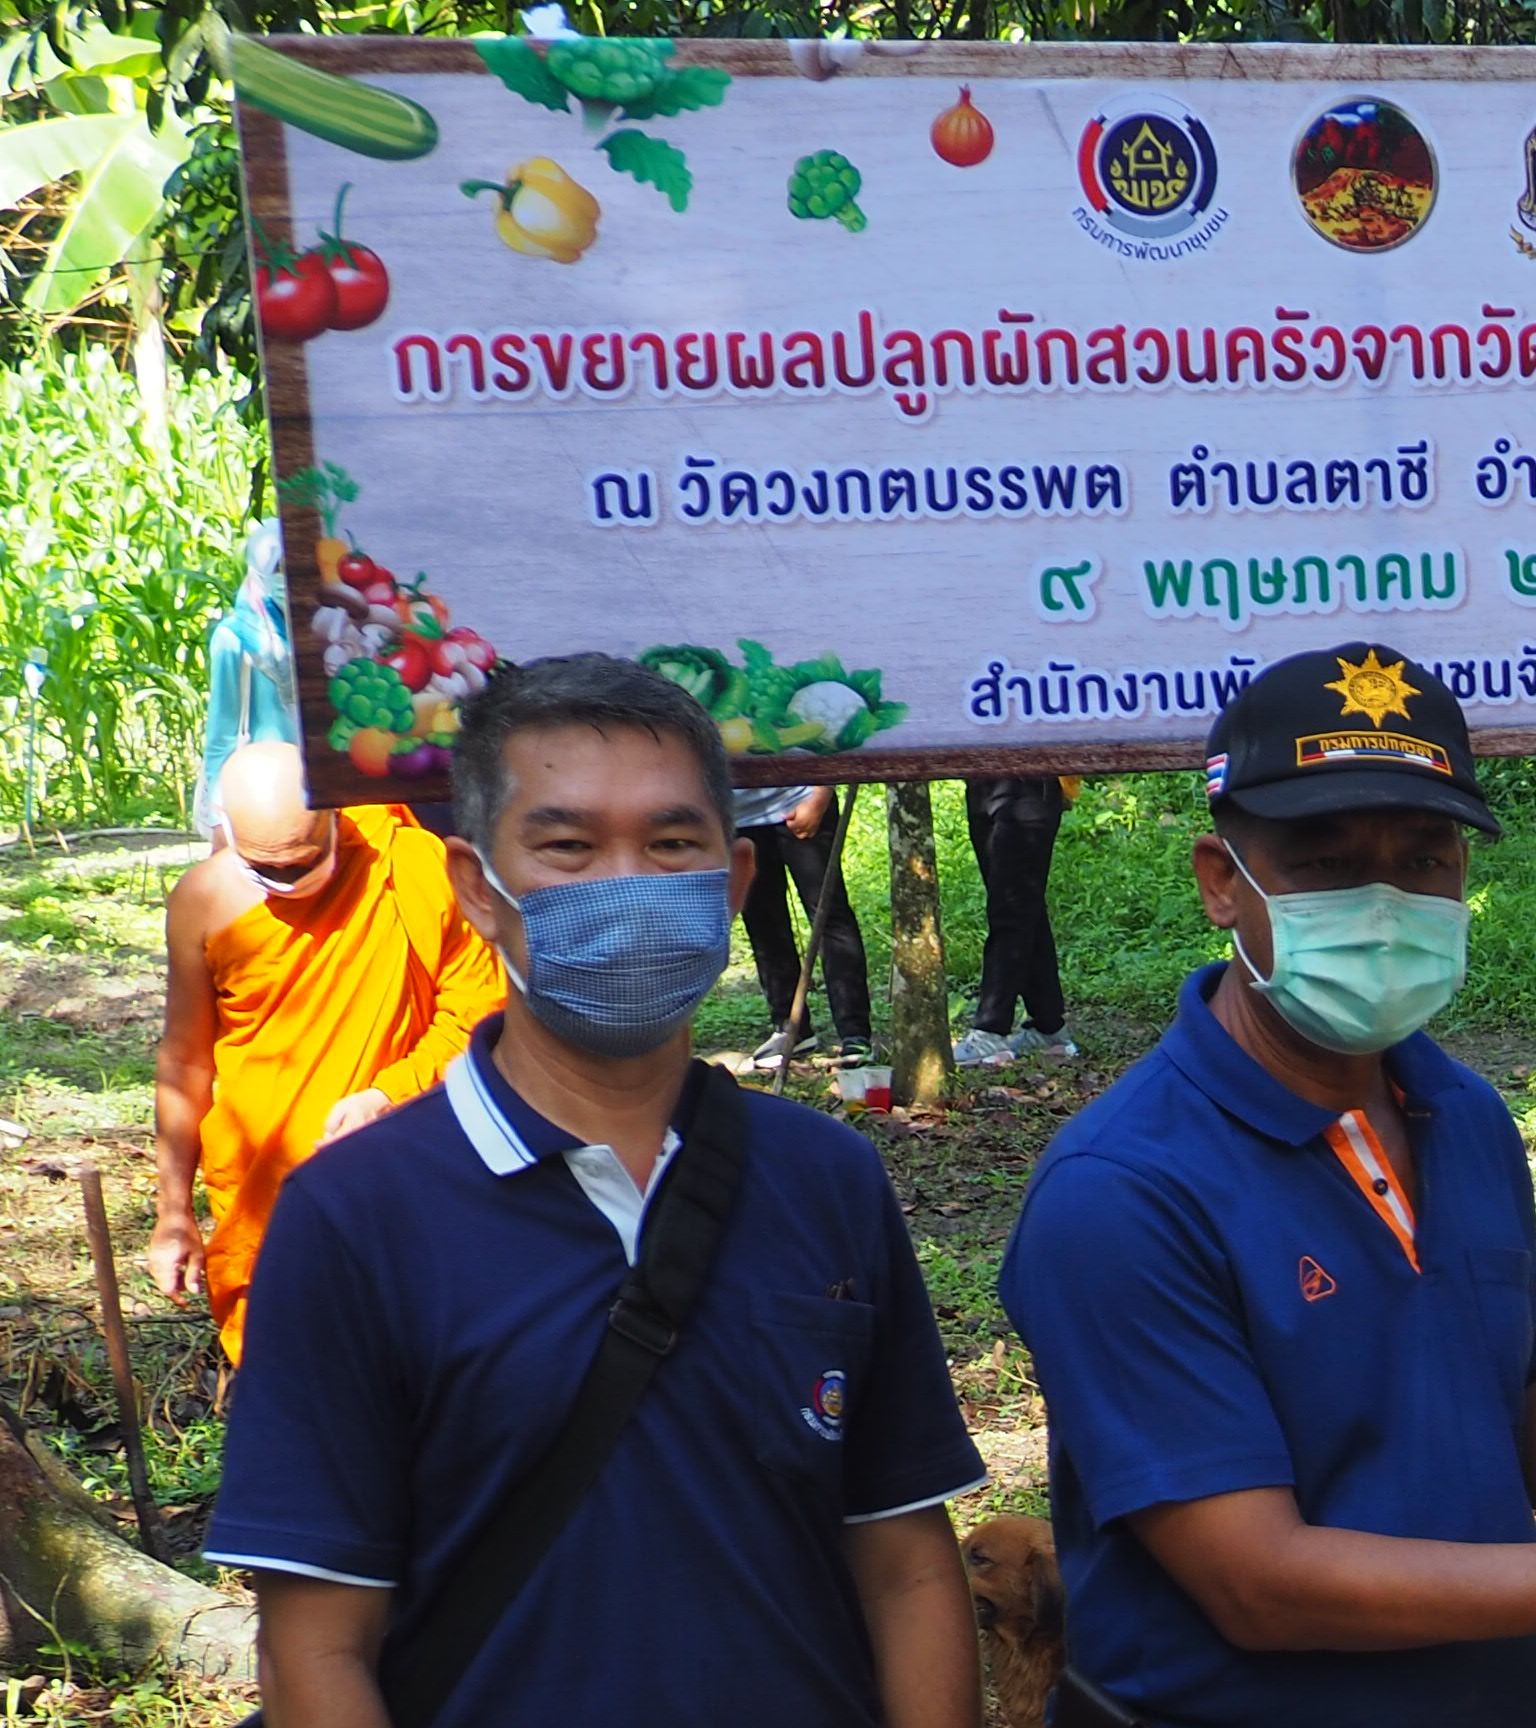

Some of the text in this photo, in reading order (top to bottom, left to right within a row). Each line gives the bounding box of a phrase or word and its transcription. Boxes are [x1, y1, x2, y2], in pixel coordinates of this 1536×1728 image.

[1072, 206, 1229, 261] กรมการพัฒนาชุมชน
[592, 472, 651, 519] ณ
[678, 455, 1122, 518] วัดวงกตบรรพต
[1170, 439, 1428, 508] ตำบลตาชี
[1039, 559, 1092, 612] ๙
[1143, 551, 1456, 621] พฤษภาคม
[1318, 734, 1434, 759] กรมการปกครอง
